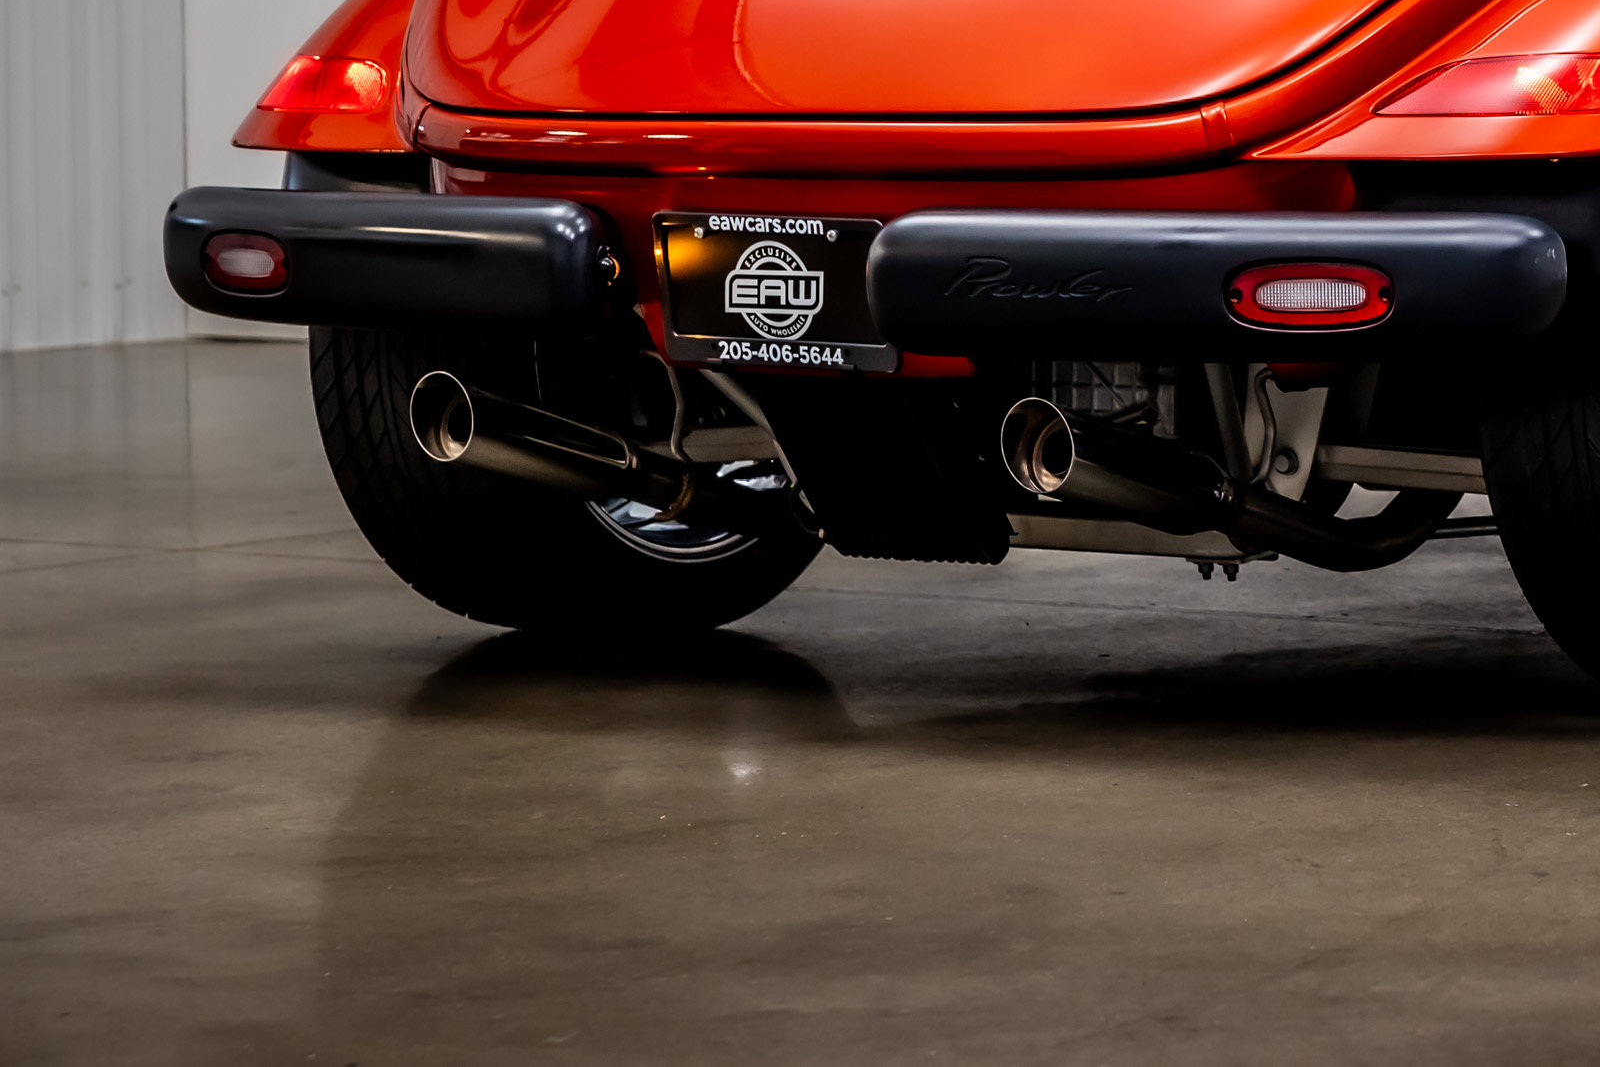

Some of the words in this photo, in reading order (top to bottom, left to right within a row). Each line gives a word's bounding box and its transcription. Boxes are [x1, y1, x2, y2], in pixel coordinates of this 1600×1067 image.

[709, 215, 824, 235] eawcars.com
[744, 247, 798, 269] EXCLUSIVE
[943, 254, 1135, 303] Prowler
[731, 278, 817, 306] EAW
[750, 314, 769, 332] AUTO
[718, 340, 844, 366] 205-406-5644
